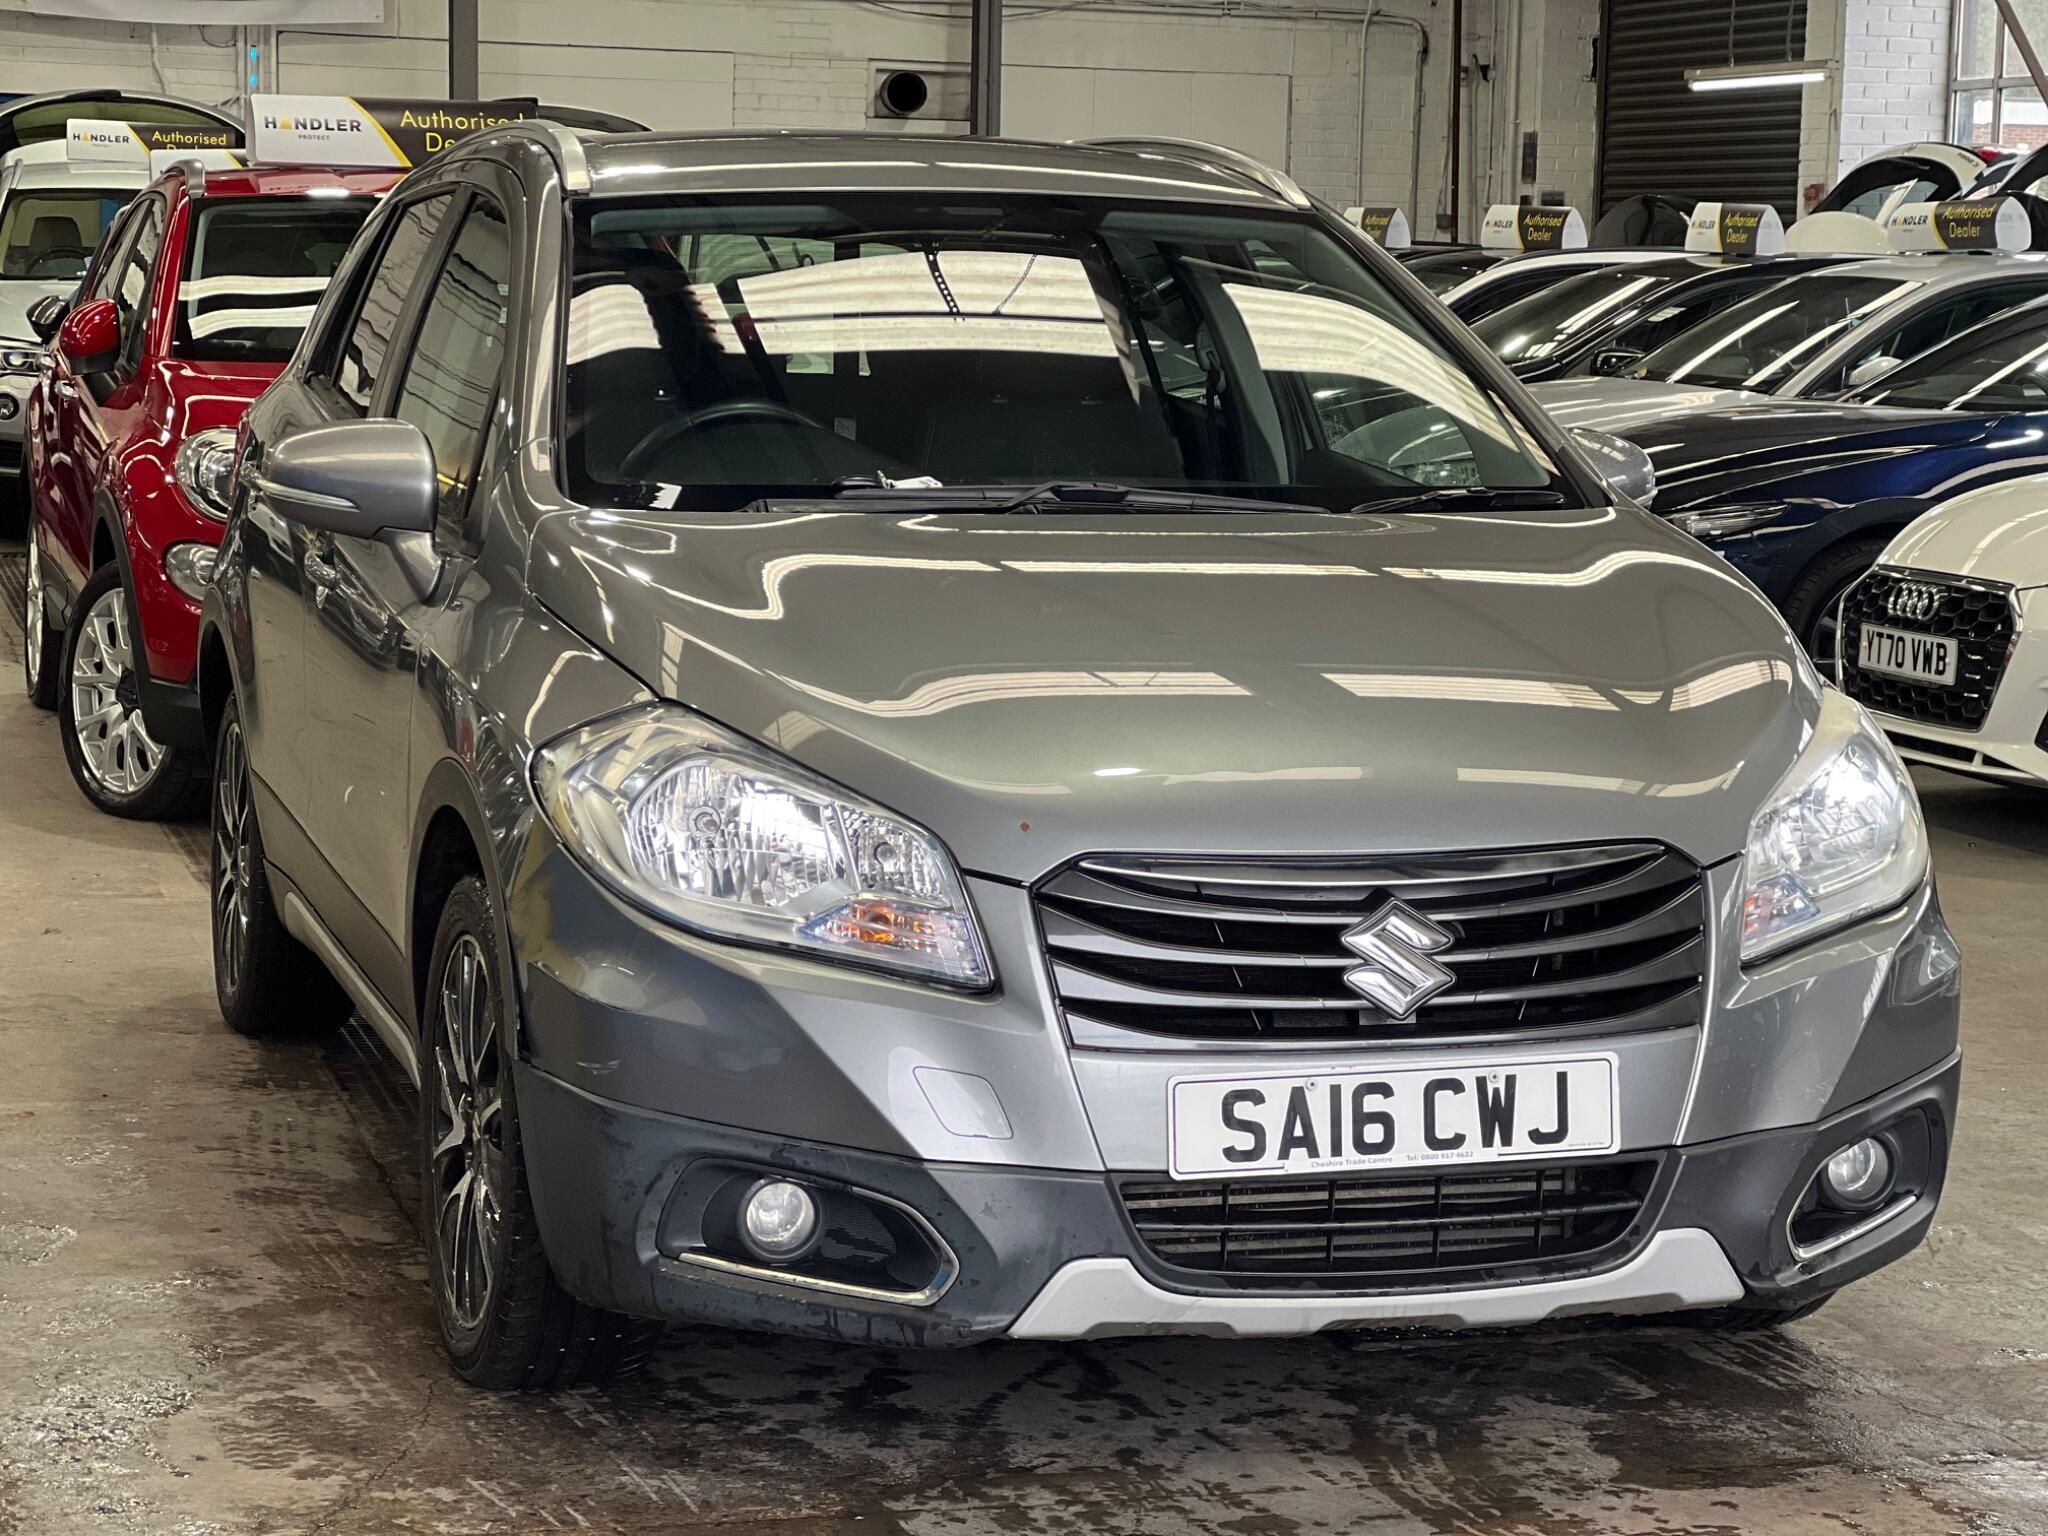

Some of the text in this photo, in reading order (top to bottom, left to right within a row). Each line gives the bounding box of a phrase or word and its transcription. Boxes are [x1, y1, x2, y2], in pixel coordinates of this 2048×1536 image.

[151, 130, 227, 146] Authorised
[1942, 202, 1998, 219] Authorised
[1523, 213, 1564, 227] Authorised
[1527, 227, 1552, 241] Dealer
[1949, 221, 1981, 238] Dealer
[1867, 629, 1947, 676] YT70 VWB
[1221, 1071, 1568, 1163] SA16 CWJ
[1311, 1159, 1343, 1168] Cheshire
[1345, 1158, 1366, 1166] Trade
[1368, 1156, 1393, 1164] Centre
